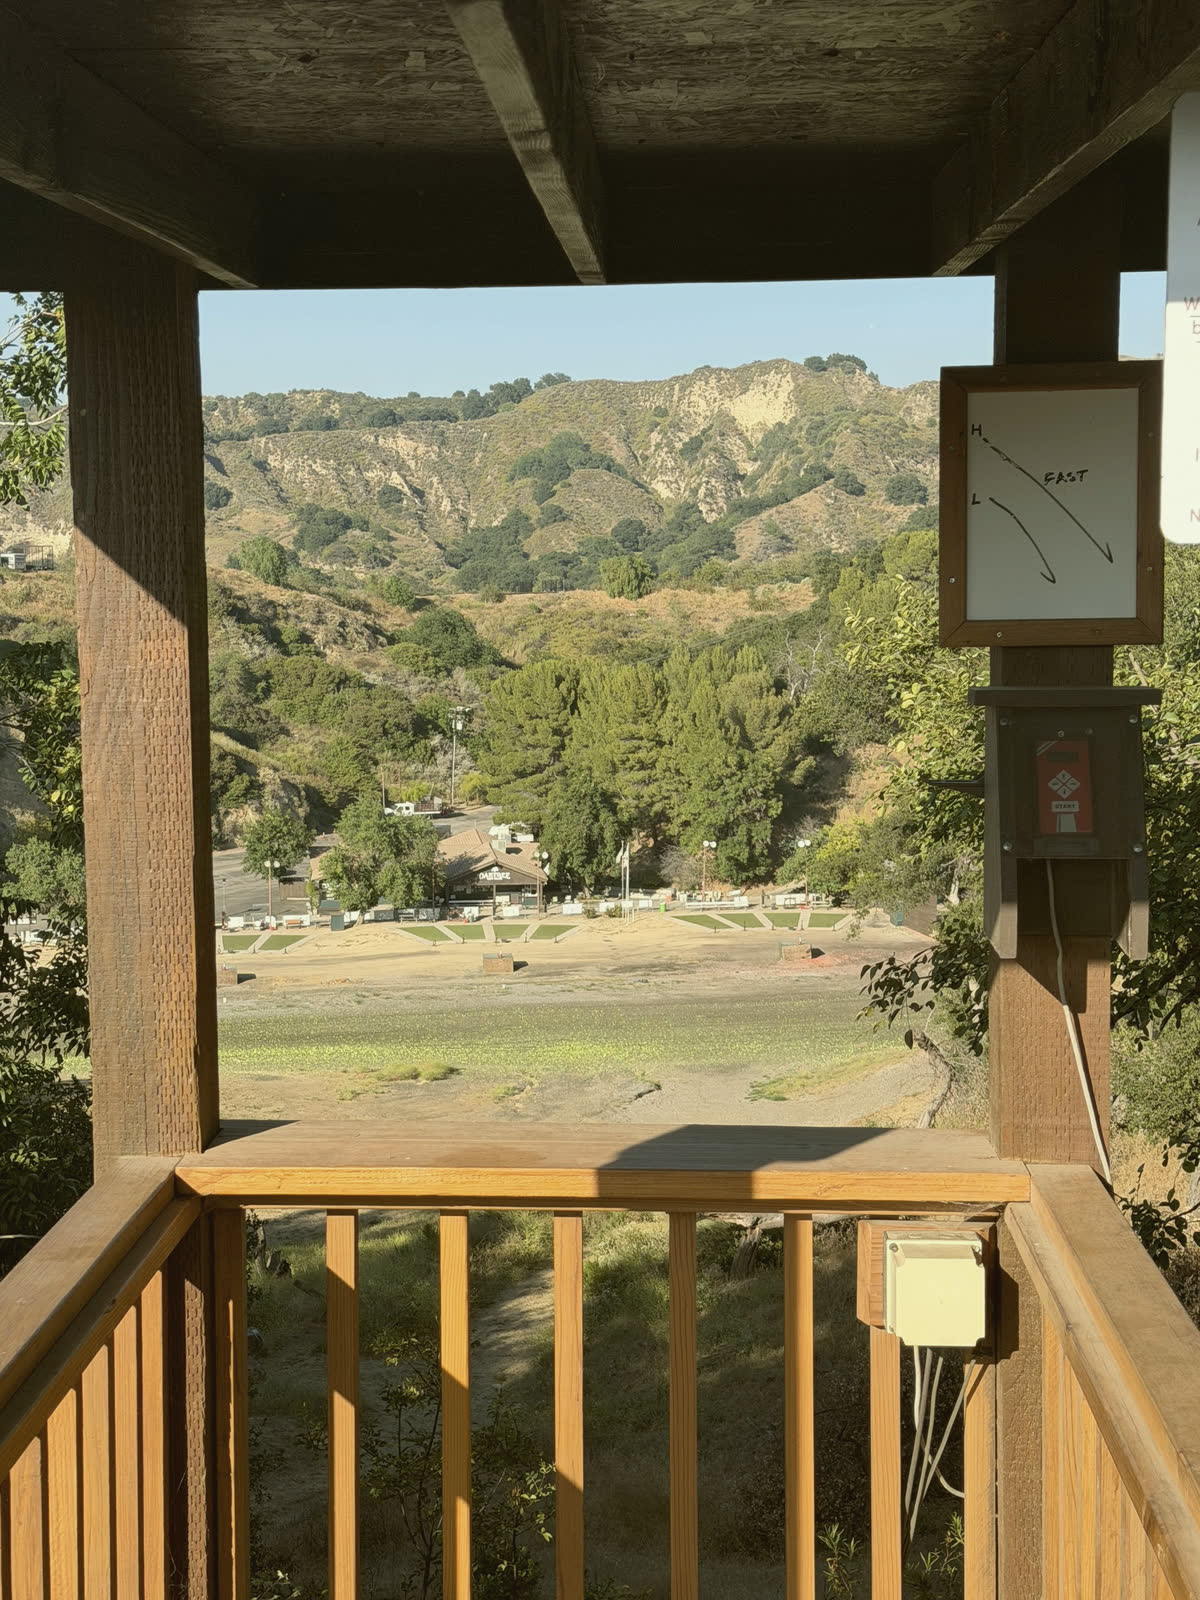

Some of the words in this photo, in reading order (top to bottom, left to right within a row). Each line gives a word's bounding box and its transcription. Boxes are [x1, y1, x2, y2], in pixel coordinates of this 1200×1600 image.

[971, 423, 982, 436] H
[1043, 468, 1089, 485] FAST
[971, 493, 981, 505] L
